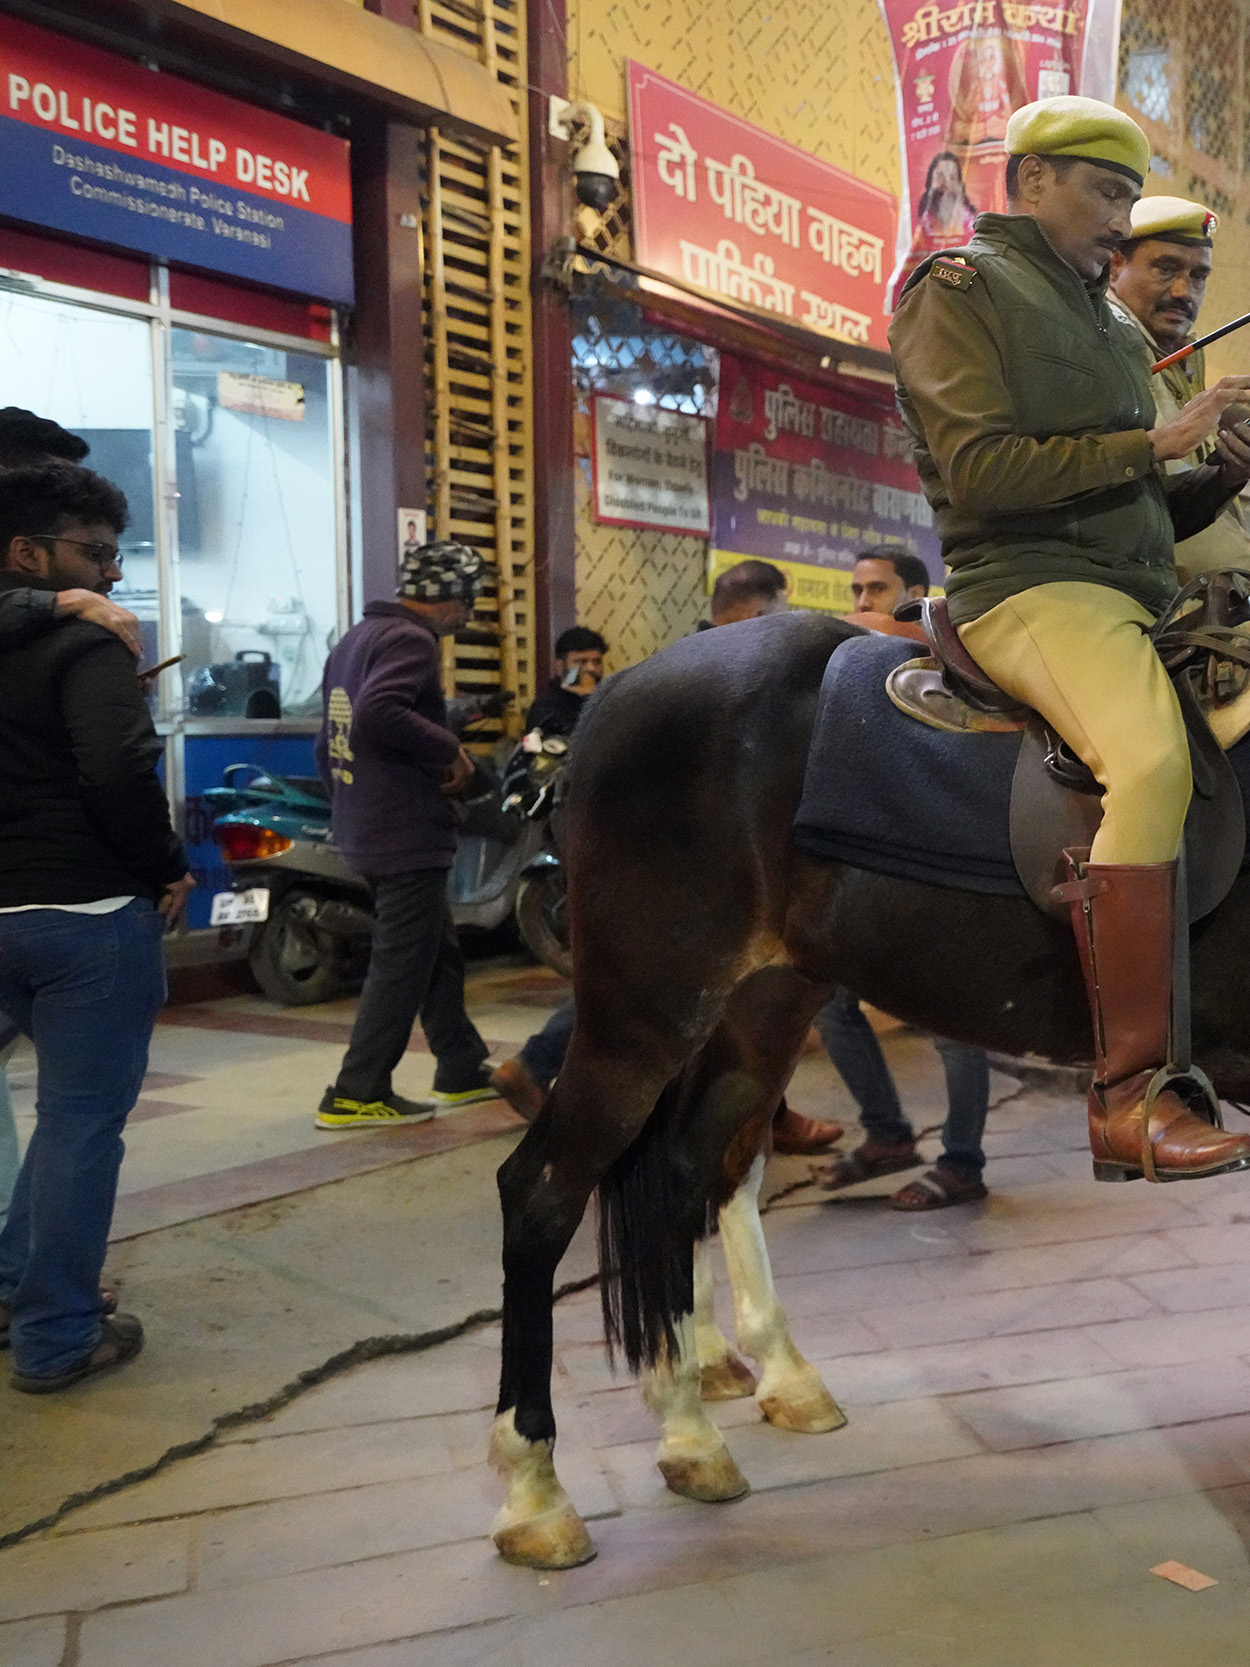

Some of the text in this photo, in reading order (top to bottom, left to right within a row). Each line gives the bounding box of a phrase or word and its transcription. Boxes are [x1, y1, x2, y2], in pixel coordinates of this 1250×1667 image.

[901, 1, 997, 48] श्रीराम
[1002, 1, 1080, 36] कथा
[9, 74, 311, 202] POLICE HELP DESK
[189, 186, 234, 216] Police
[236, 201, 285, 231] Station
[654, 123, 884, 284] दो पहिया वाहन
[211, 216, 271, 249] Varanasi
[764, 384, 816, 441] पुलिस
[733, 442, 789, 501] पुलिस
